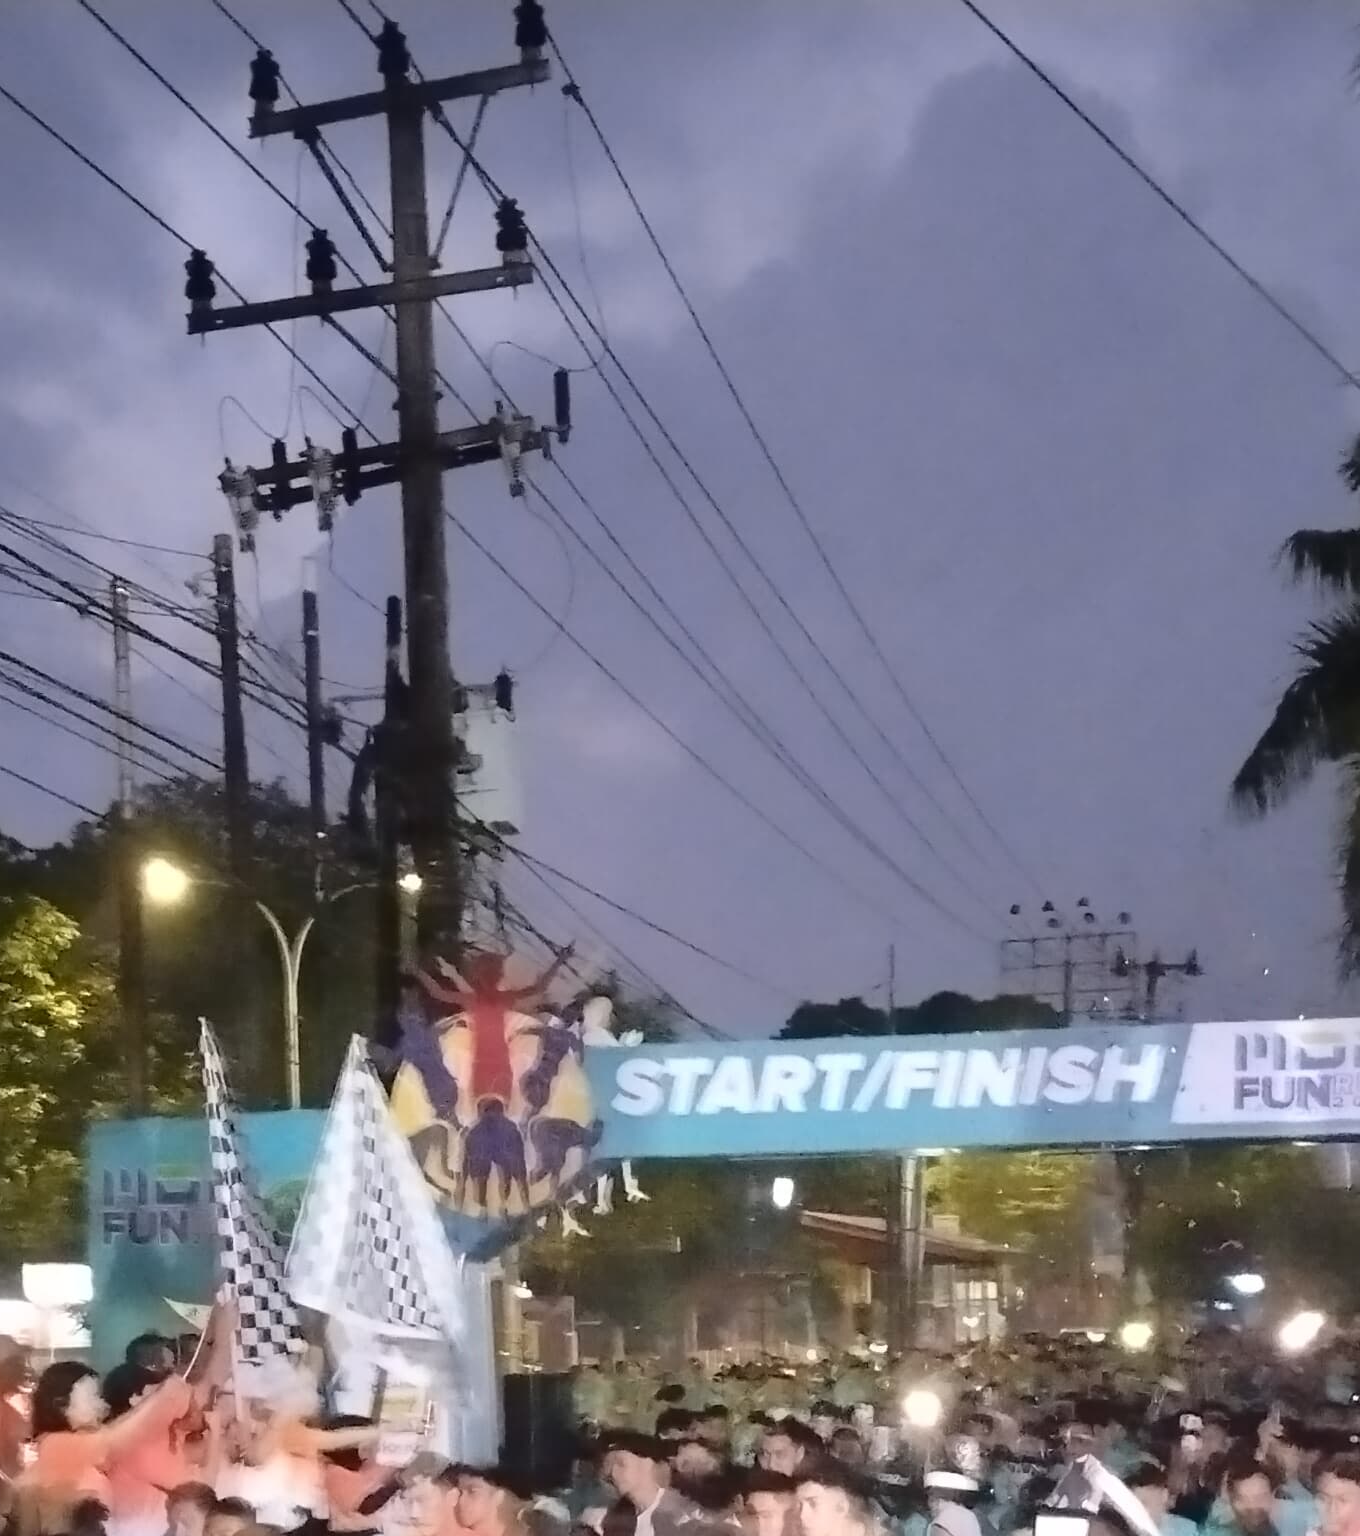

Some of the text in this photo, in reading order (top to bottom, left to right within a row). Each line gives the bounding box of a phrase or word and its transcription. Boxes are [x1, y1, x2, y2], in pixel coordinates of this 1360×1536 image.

[612, 1044, 1163, 1116] START/FINISH
[1234, 1075, 1331, 1110] FUN
[102, 1210, 191, 1245] FUN
